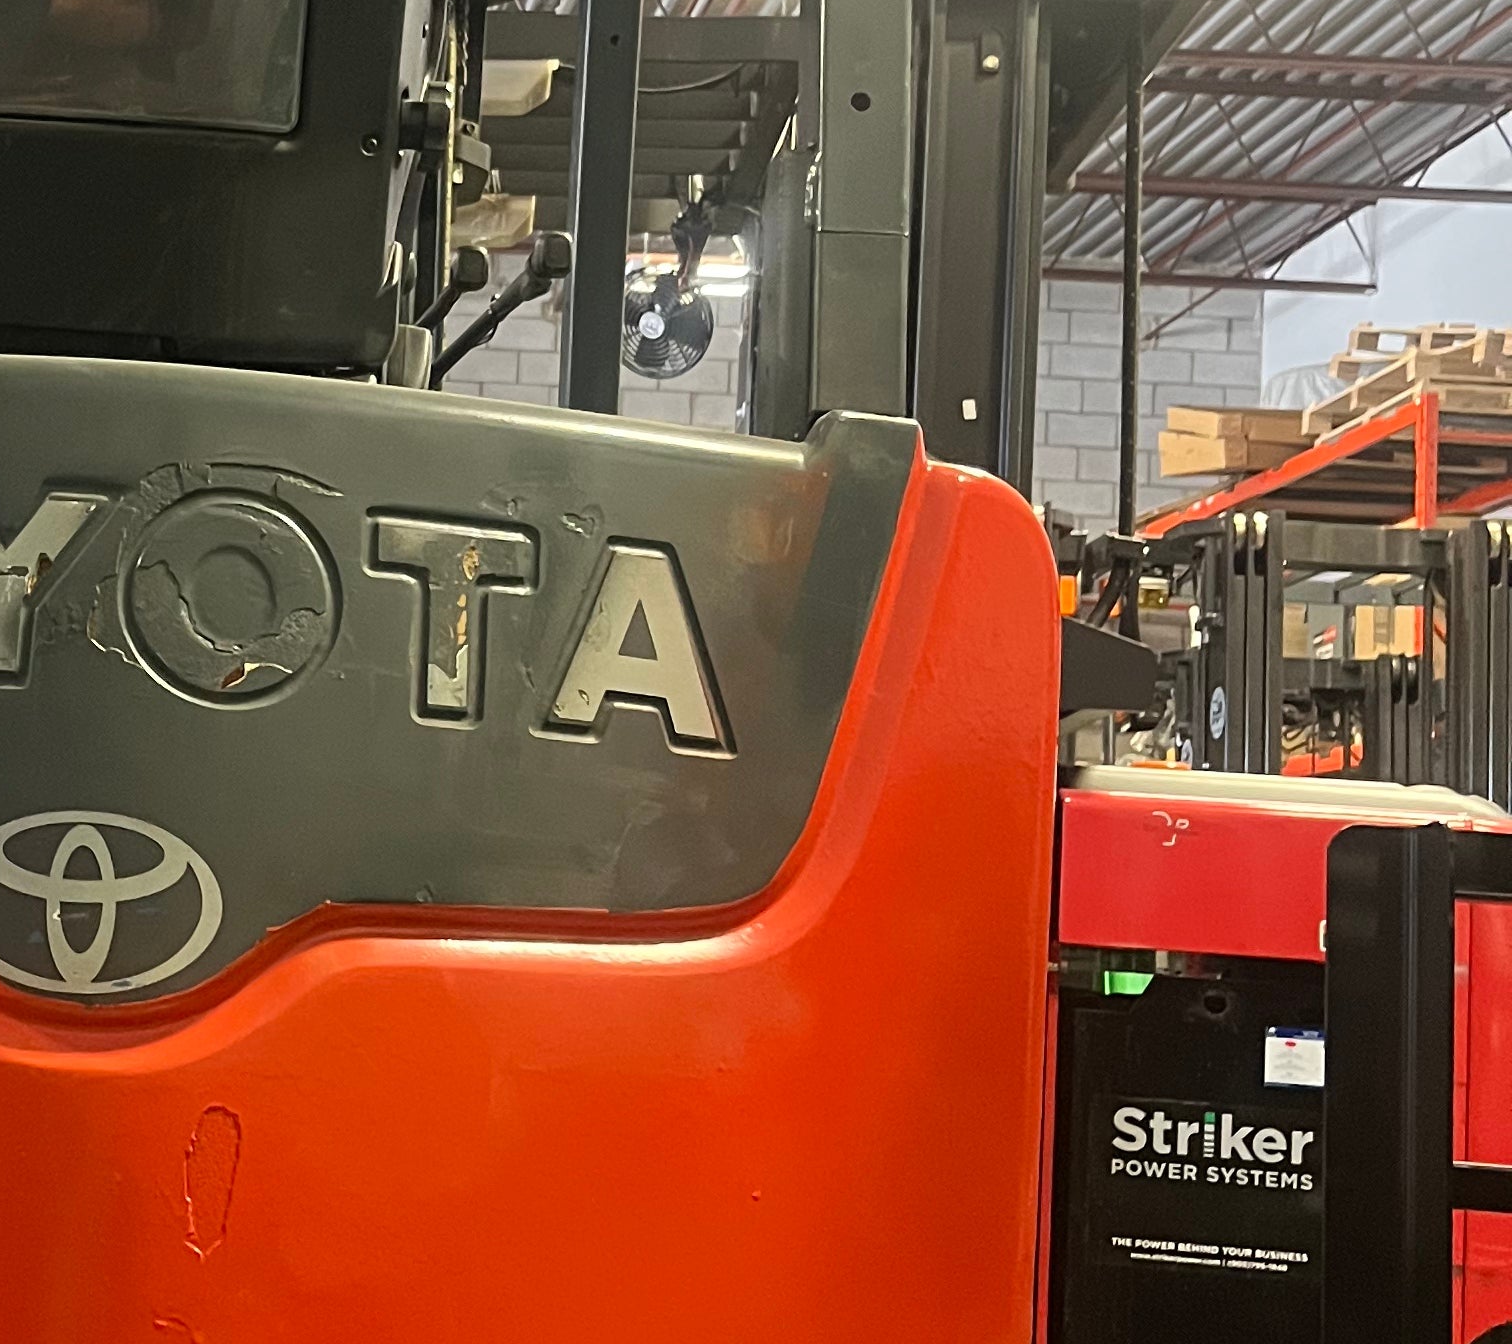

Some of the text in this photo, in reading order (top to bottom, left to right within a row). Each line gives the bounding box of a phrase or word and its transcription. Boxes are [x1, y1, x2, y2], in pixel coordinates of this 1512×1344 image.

[1111, 1106, 1314, 1165] Striker
[1110, 1158, 1314, 1191] POWER SYSTEMS
[1111, 1236, 1309, 1263] THE POWER BEHIND YOUR BUSINESS
